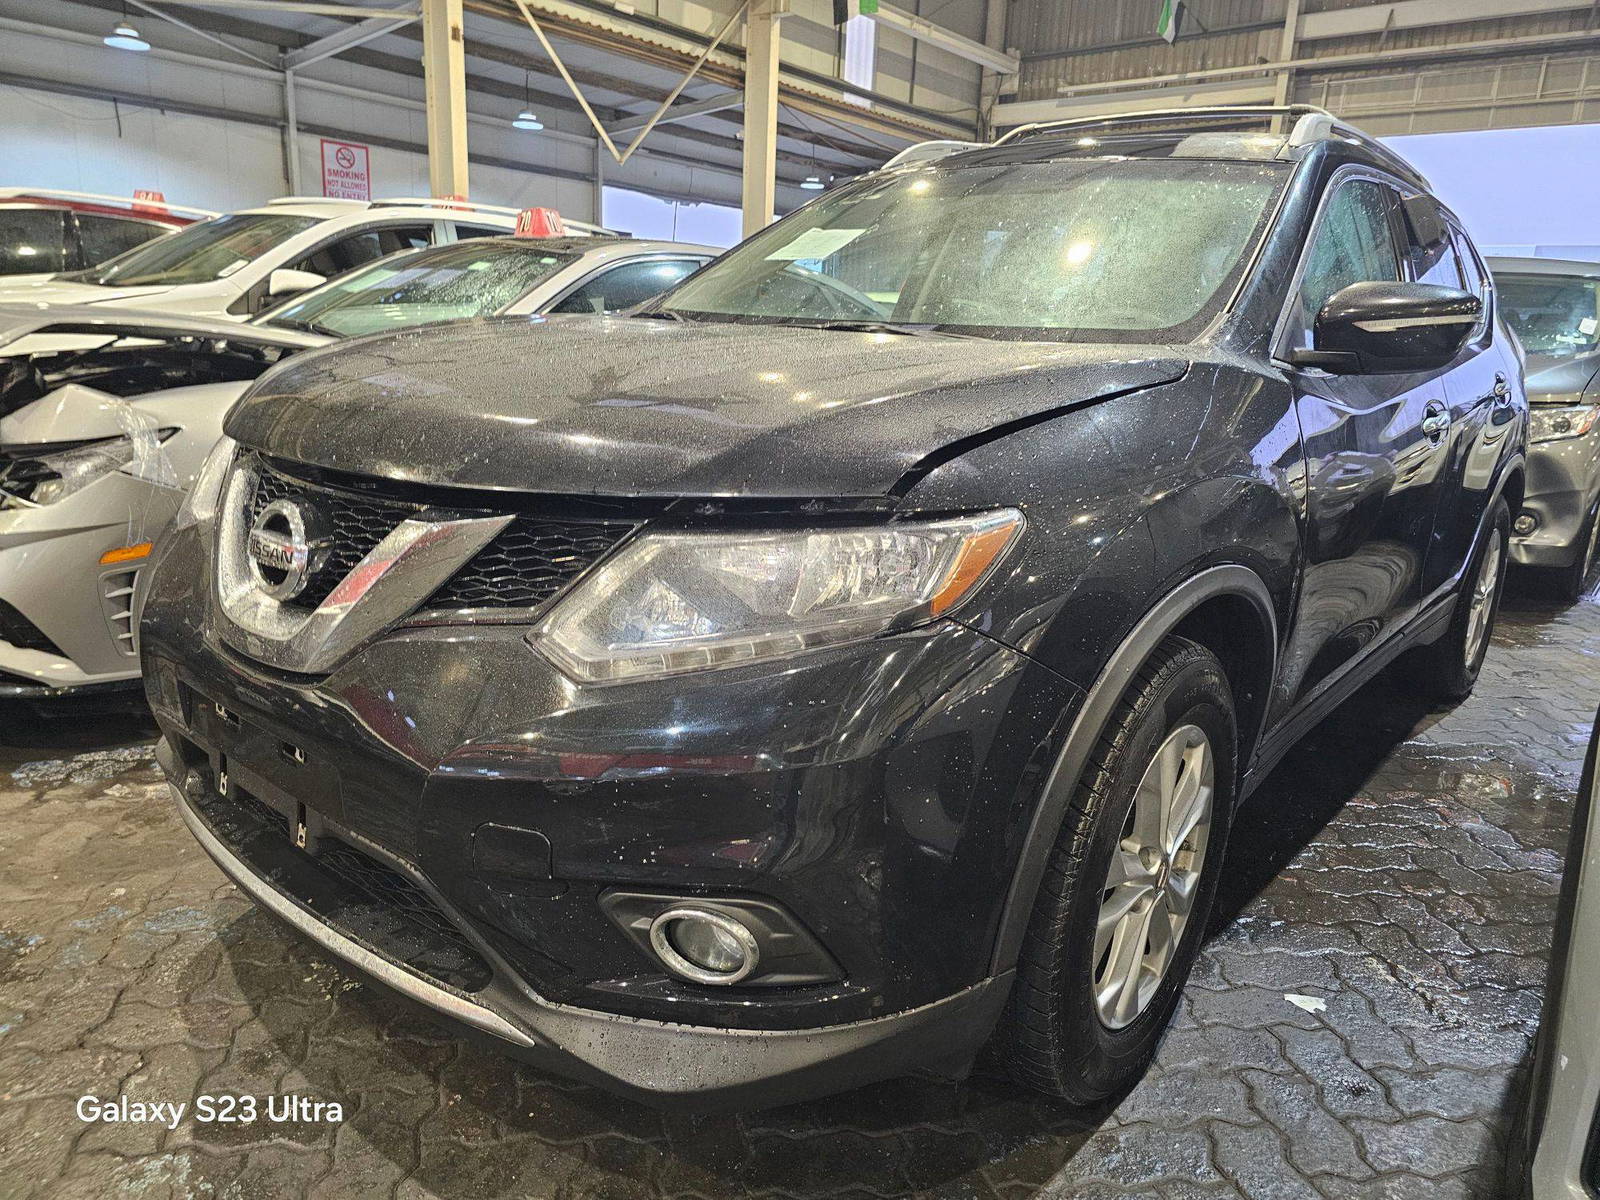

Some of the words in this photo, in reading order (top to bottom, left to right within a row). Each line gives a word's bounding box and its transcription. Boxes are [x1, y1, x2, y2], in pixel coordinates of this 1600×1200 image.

[327, 168, 366, 181] SMOKING
[327, 179, 339, 187] NOT
[341, 181, 367, 190] ALLOWED
[328, 190, 340, 198] NO
